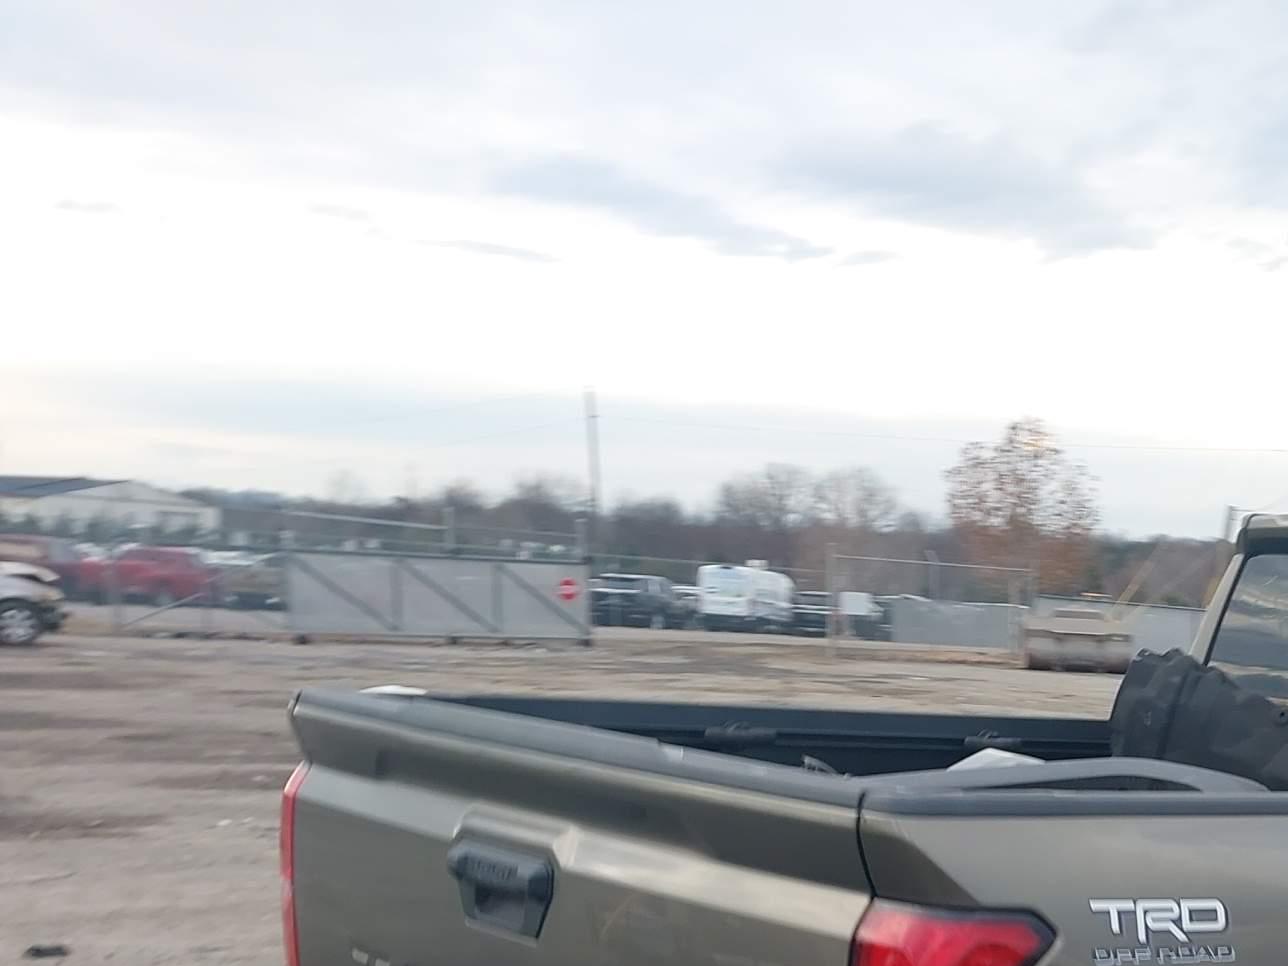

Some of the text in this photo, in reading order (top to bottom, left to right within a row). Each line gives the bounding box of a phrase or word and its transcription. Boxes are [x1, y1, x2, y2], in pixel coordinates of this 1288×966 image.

[1089, 897, 1229, 945] TRD
[1092, 944, 1236, 966] OFF ROAD
